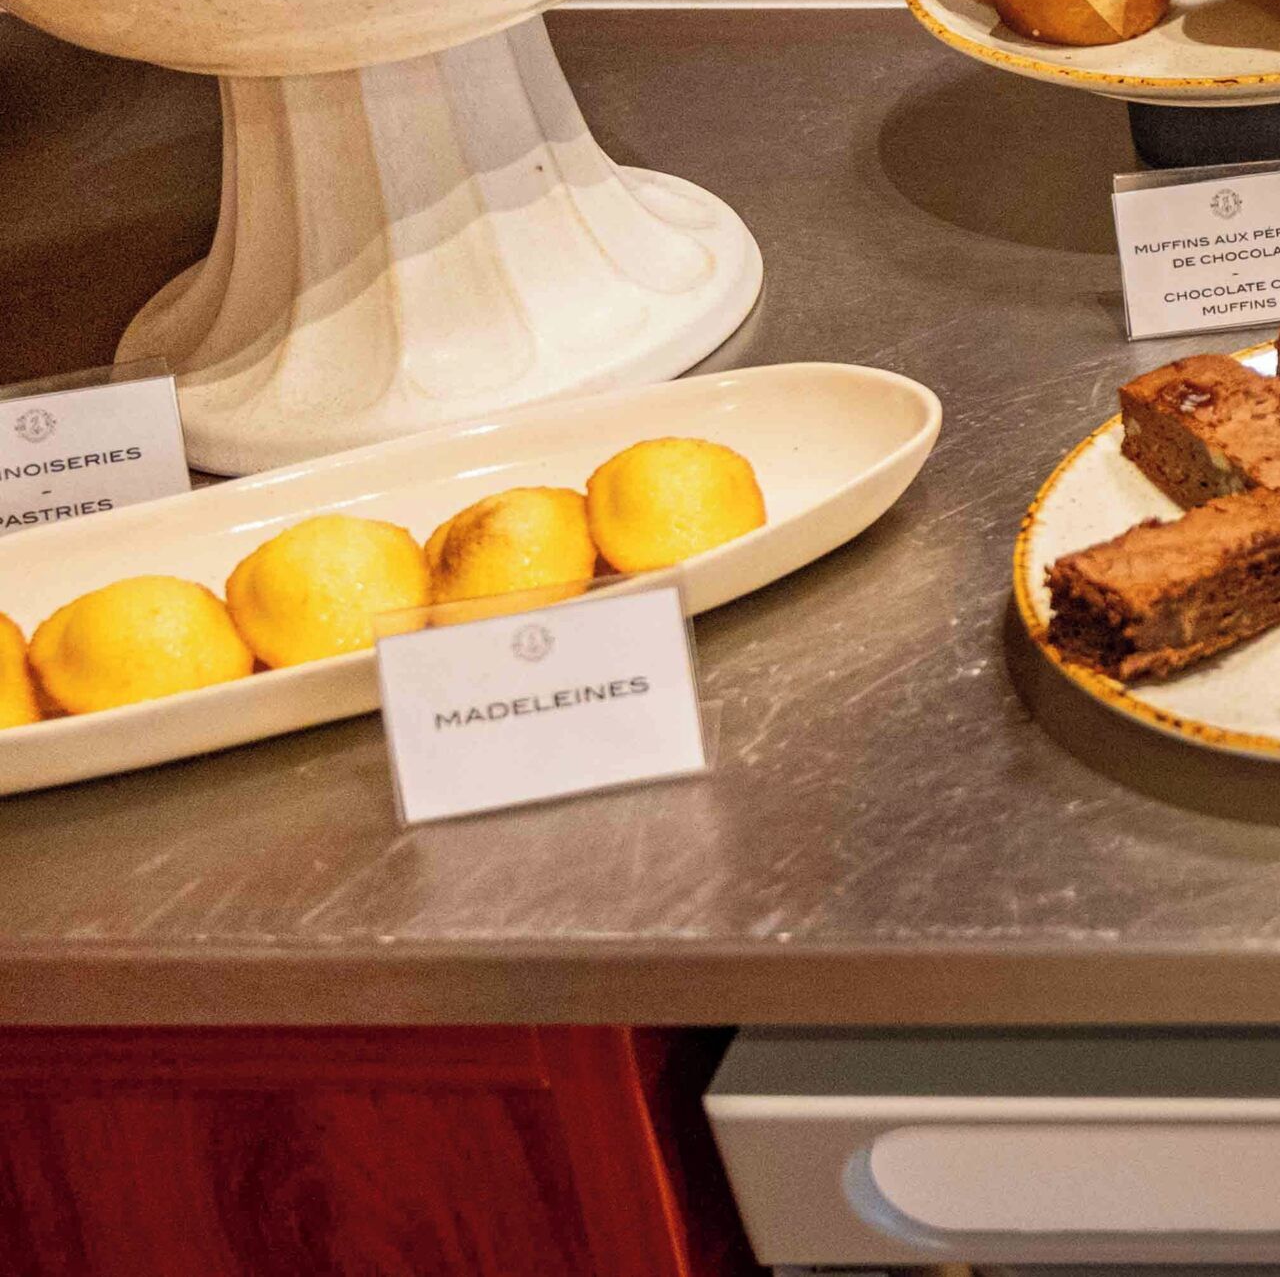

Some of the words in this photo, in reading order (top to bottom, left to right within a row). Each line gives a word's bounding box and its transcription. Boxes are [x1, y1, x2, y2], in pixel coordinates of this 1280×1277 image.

[1134, 236, 1210, 255] MUFFINS
[1214, 231, 1249, 246] AUX
[1173, 255, 1196, 269] DE
[1163, 280, 1266, 303] CHOCOLATE
[1201, 297, 1277, 316] MUFFINS
[0, 446, 142, 481] NOISERIES
[434, 675, 650, 731] MADELEINES
